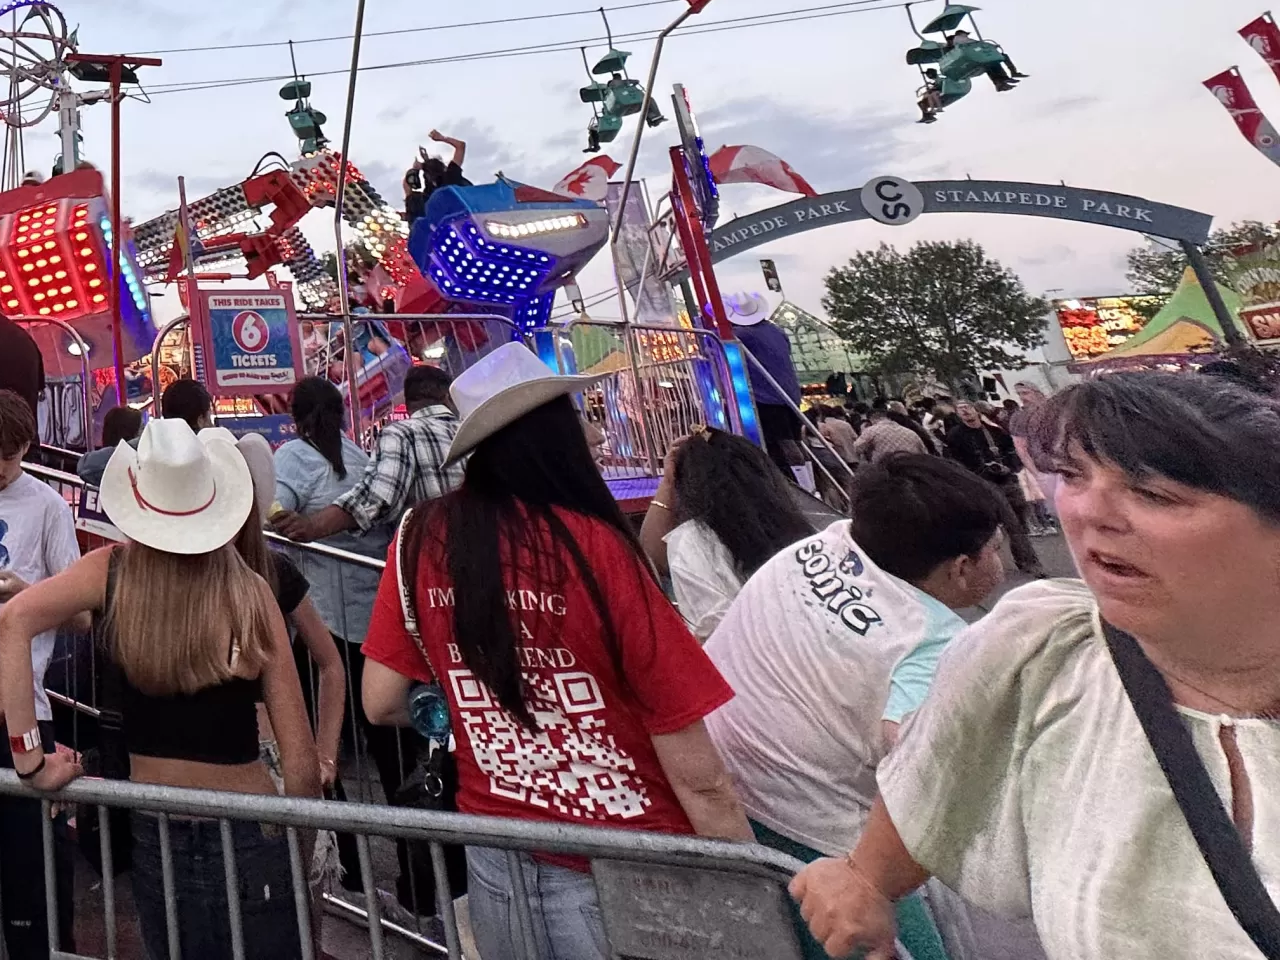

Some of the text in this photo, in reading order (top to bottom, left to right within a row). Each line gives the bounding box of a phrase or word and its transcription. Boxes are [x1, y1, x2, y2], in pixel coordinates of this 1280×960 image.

[935, 190, 1153, 223] STAMPEDE PARK
[712, 199, 852, 253] AMPEDE PARK
[213, 298, 280, 307] THIS RIDE TAKES
[241, 314, 262, 348] 6
[231, 354, 277, 367] TICKETS
[427, 587, 456, 608] I'M
[504, 589, 567, 616] KING
[446, 642, 576, 669] BIEND
